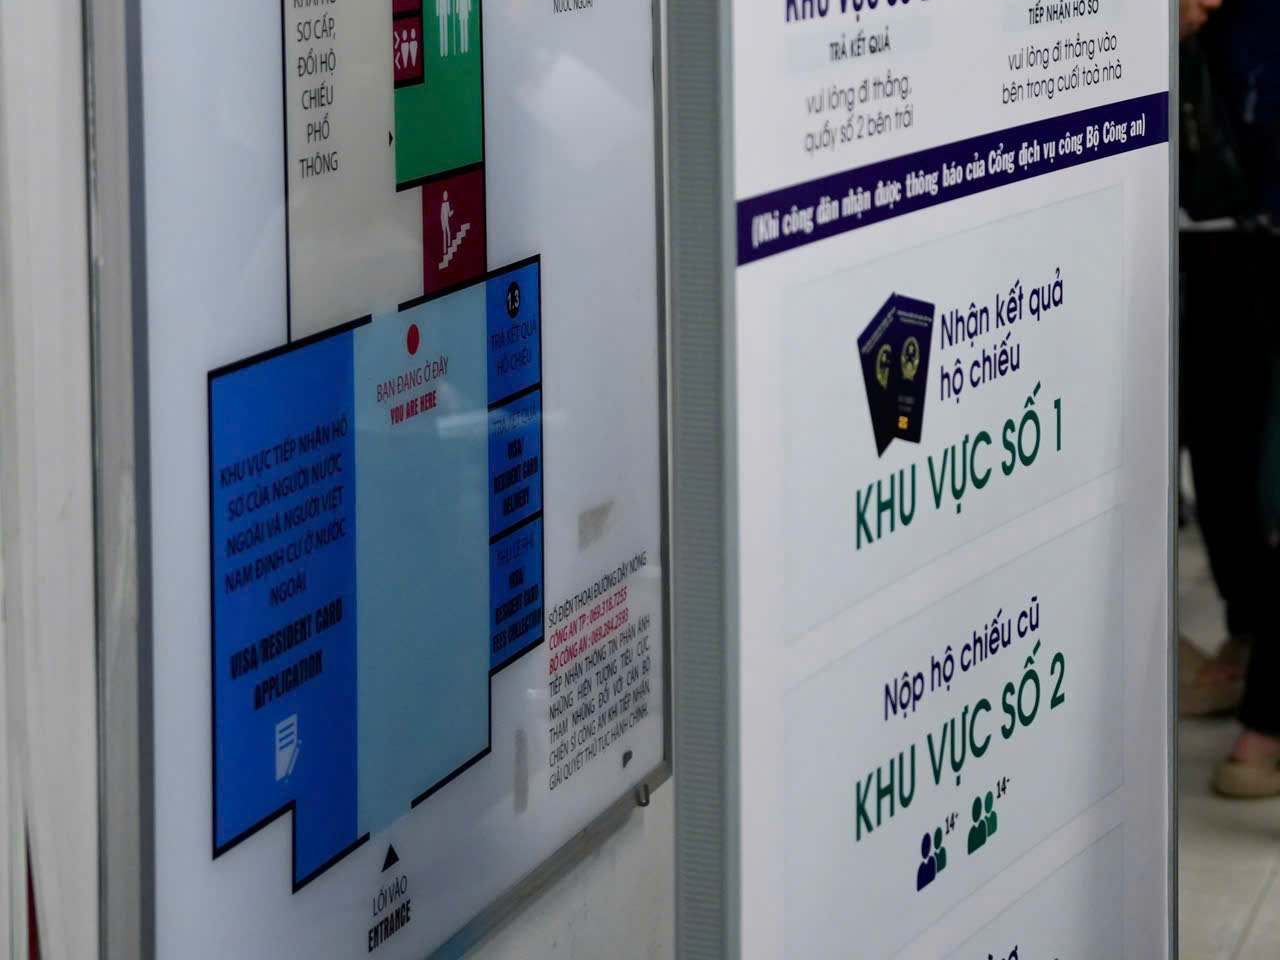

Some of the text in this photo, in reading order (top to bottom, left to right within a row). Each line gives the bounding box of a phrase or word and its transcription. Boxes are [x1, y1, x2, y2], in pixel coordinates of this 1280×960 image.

[297, 12, 336, 43] SƠ CẤP,
[1028, 0, 1044, 25] TIẾP
[1046, 0, 1071, 24] NHẬN
[297, 47, 336, 77] ĐỔI HỘ
[829, 25, 891, 62] TRẢ KẾT QUẢ
[1008, 31, 1117, 71] vui lòng đi thẳng vào
[301, 80, 334, 110] CHIẾU
[807, 88, 825, 114] vui
[828, 84, 855, 112] lòng
[858, 79, 869, 103] đi
[1002, 59, 1122, 104] bên trong cuối toà nhà
[804, 103, 913, 155] quầy số 2 bên trái
[299, 151, 338, 179] THÔNG
[752, 113, 1146, 249] (Khi công dân nhận được thông báo của Cổng dịch vụ công Bộ Công an)
[941, 301, 990, 350] Nhận
[996, 278, 1025, 329] kết
[1029, 267, 1064, 322] quả
[940, 331, 1021, 404] hộ chiếu
[390, 390, 437, 425] YOU ARE HERE
[856, 380, 1062, 551] KHU VỰC SỐ 1
[884, 595, 1040, 721] Nộp hộ chiếu cũ
[856, 639, 1065, 842] KHU VỰC SỐ 2
[389, 875, 407, 903] VÀO
[368, 899, 411, 953] ENTRANCE
